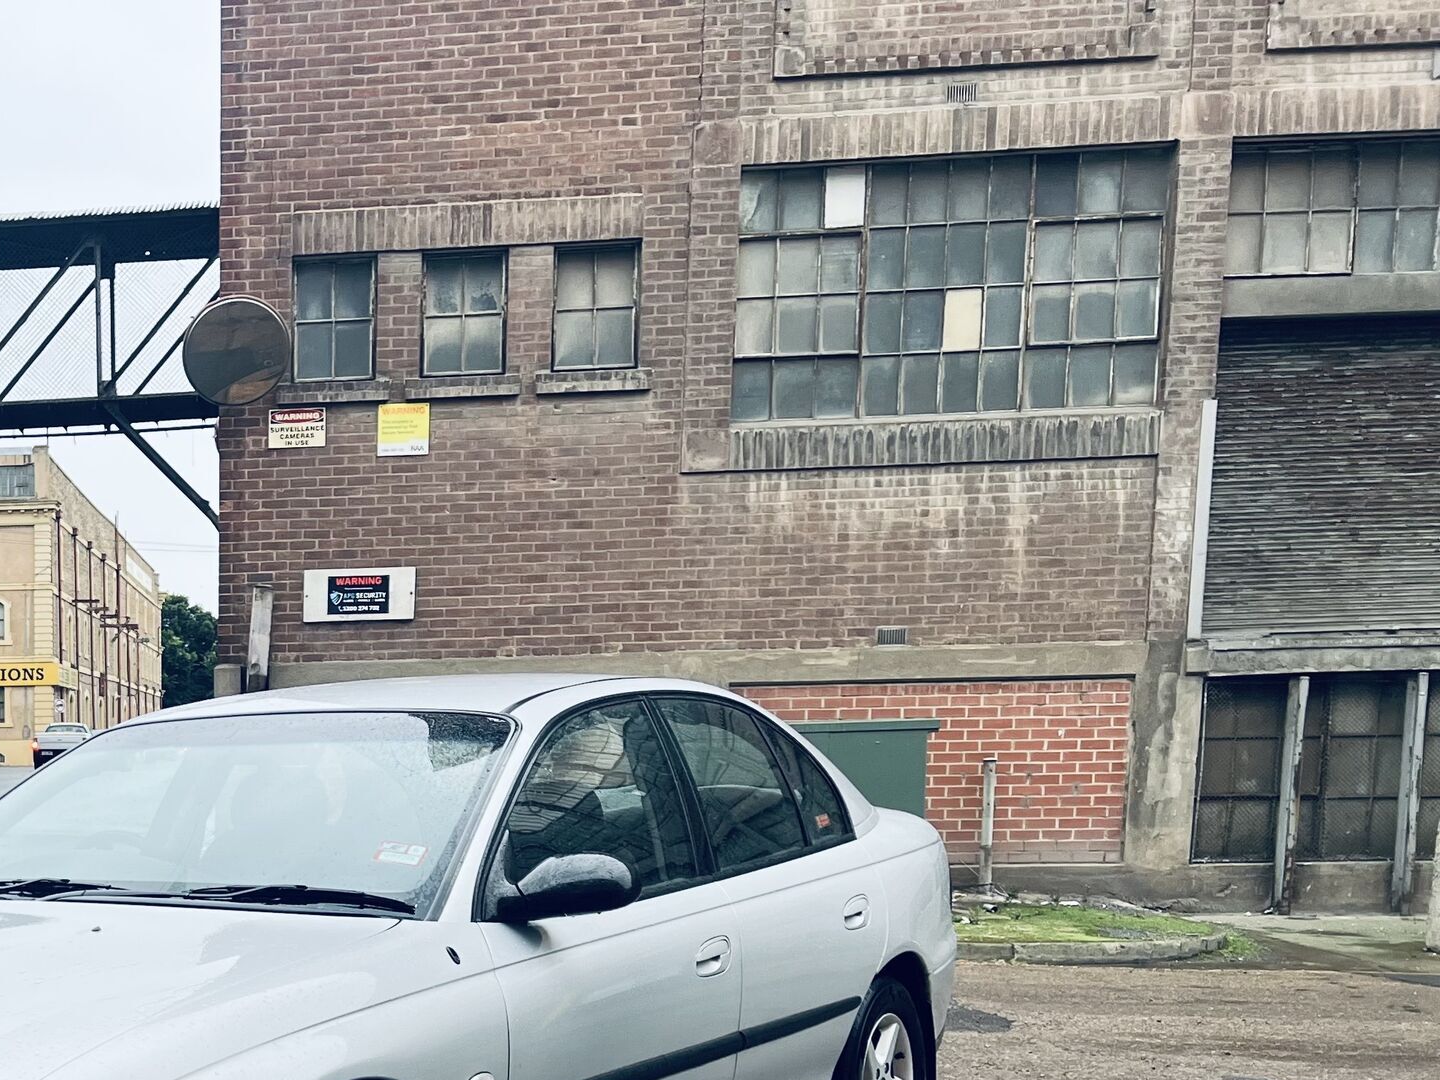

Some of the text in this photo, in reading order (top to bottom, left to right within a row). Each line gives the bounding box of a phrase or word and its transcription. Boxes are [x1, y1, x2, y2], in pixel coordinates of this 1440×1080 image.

[382, 406, 426, 415] WARNING
[275, 412, 320, 421] WARNING
[270, 425, 325, 433] SURVEILLANCE
[280, 432, 315, 440] CAMERAS
[336, 577, 382, 585] WARNING
